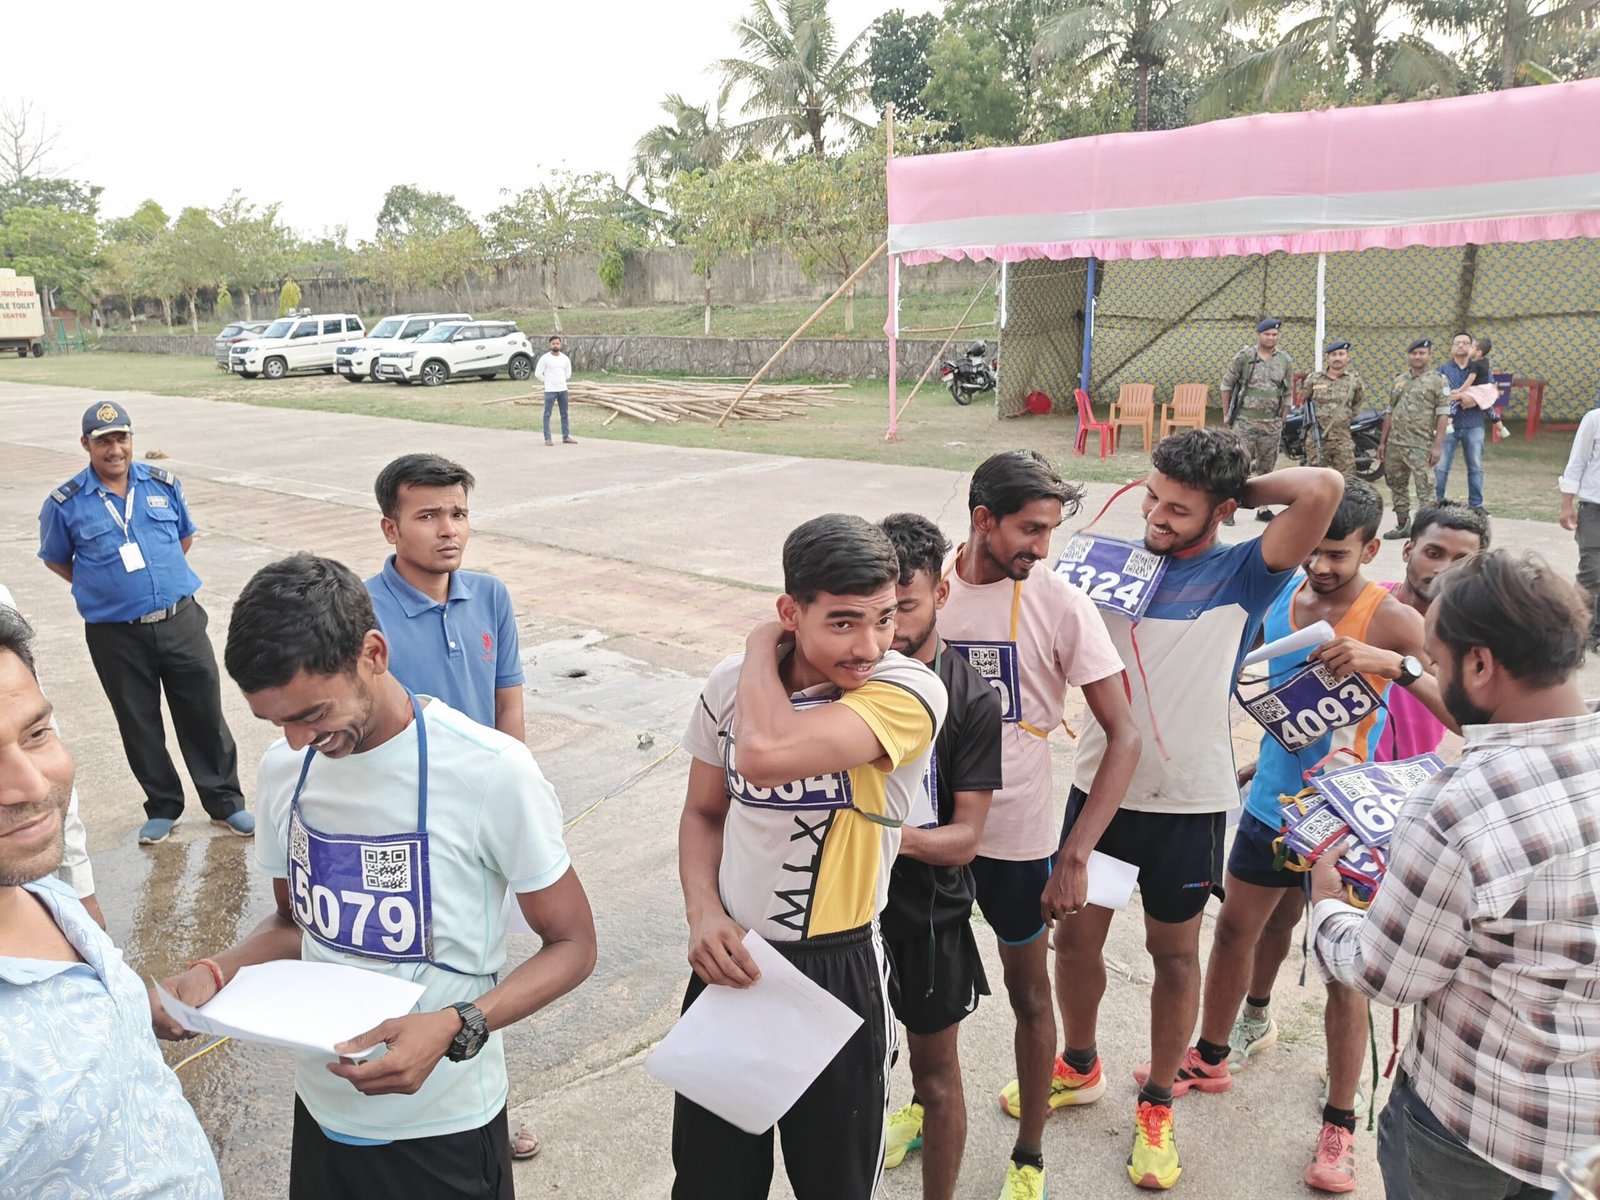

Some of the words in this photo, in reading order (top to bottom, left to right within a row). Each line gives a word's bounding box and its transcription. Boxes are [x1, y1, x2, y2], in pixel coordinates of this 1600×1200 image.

[11, 302, 35, 310] TOILET
[1281, 684, 1371, 745] 4093
[295, 866, 416, 953] 5079
